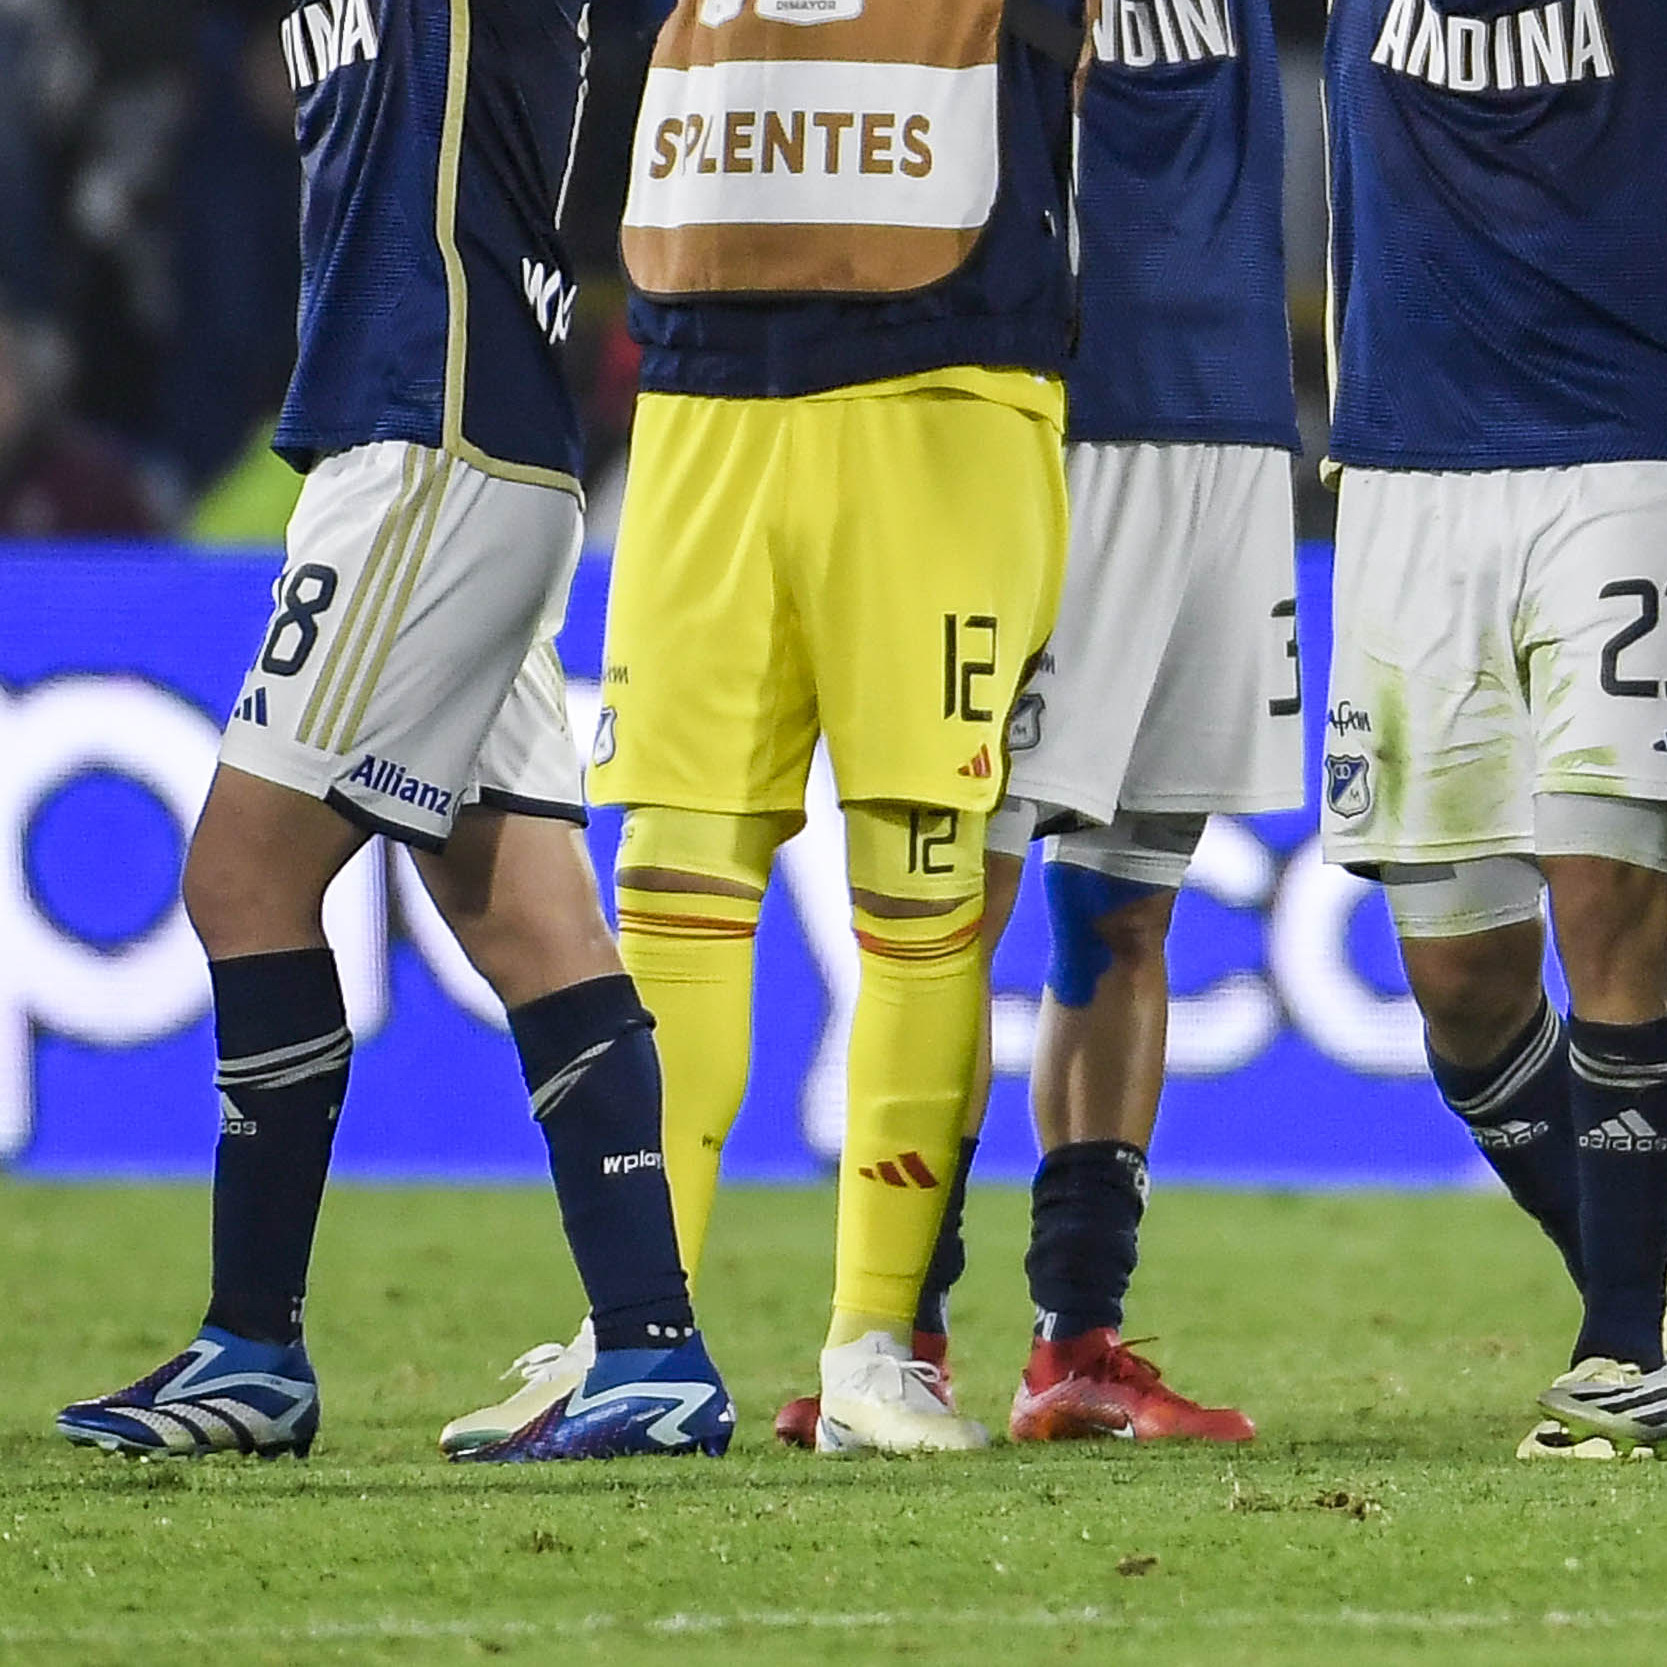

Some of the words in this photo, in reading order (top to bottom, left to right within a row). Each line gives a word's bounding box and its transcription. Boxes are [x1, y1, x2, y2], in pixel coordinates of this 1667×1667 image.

[943, 614, 997, 722] 12
[351, 754, 452, 816] Allianz
[1579, 1136, 1667, 1151] adidas
